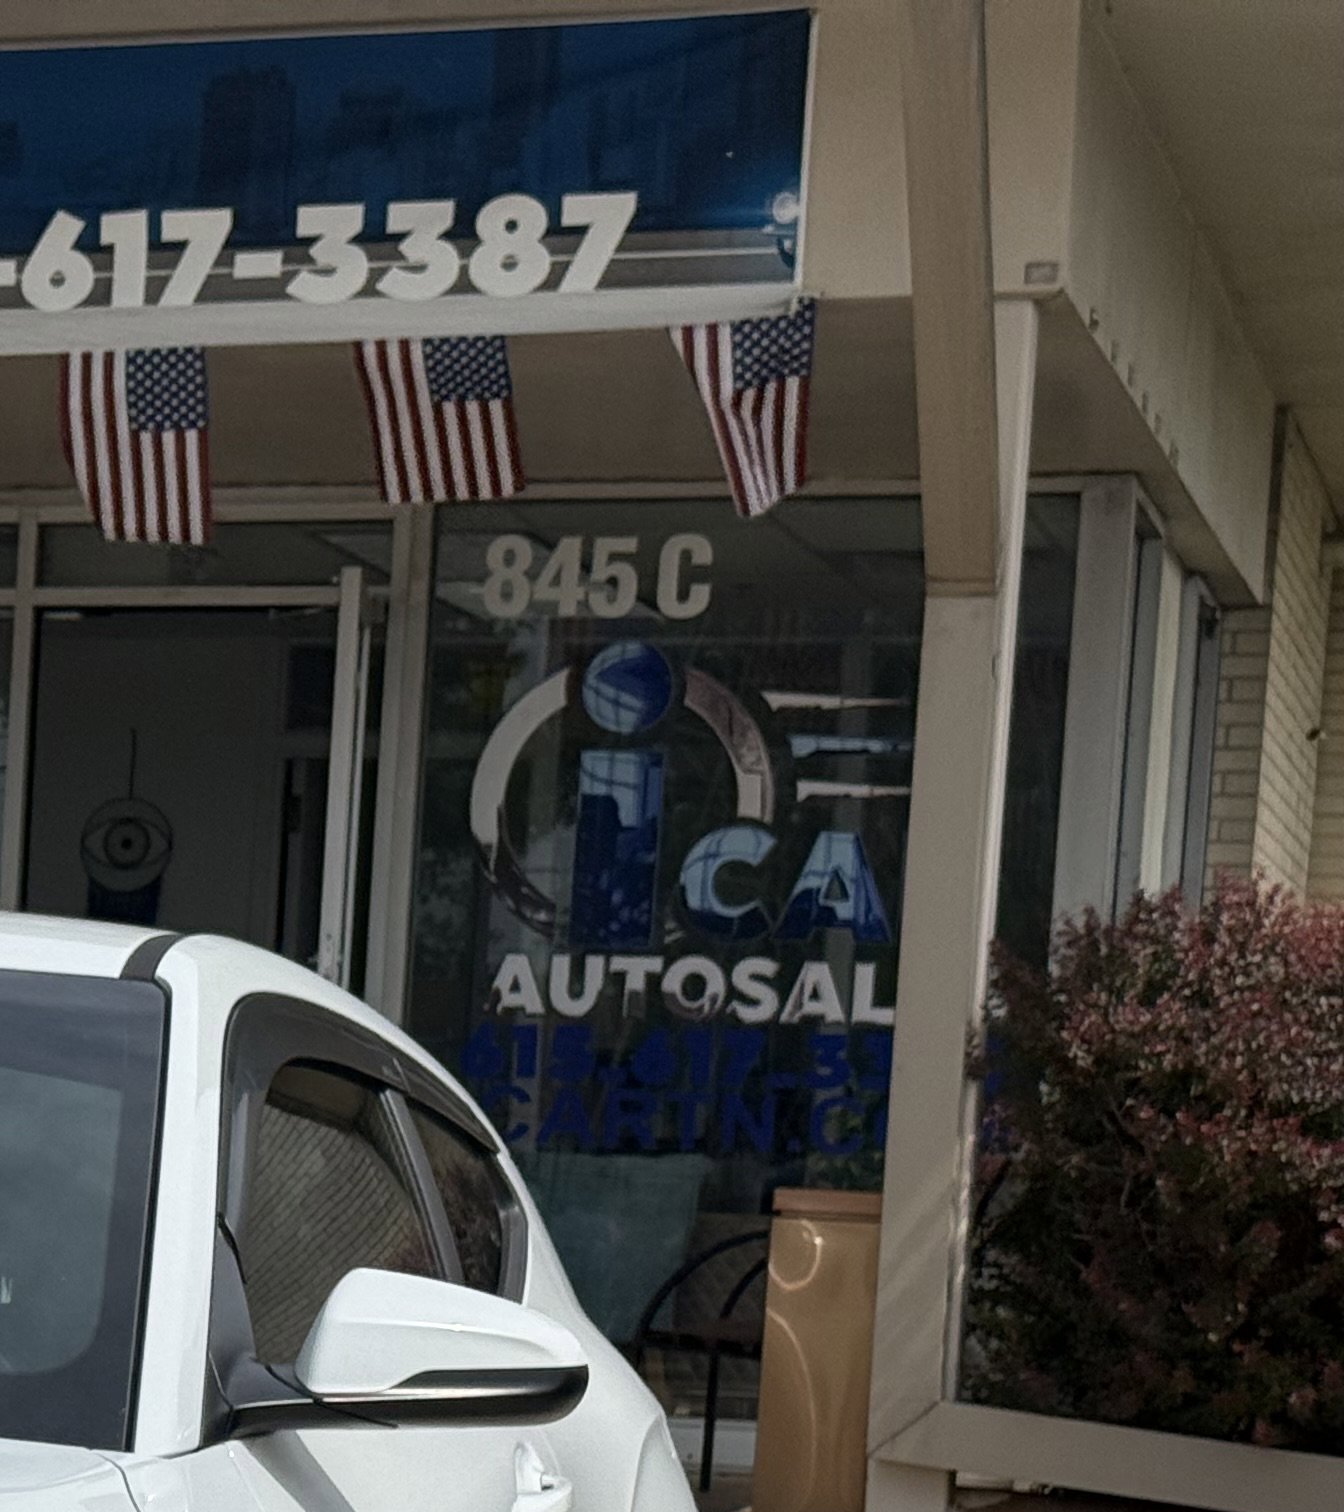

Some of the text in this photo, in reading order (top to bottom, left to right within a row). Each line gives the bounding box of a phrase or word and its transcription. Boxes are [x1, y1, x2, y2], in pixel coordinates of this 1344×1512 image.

[482, 532, 713, 619] 845 C
[480, 1081, 887, 1155] CARTN.C
